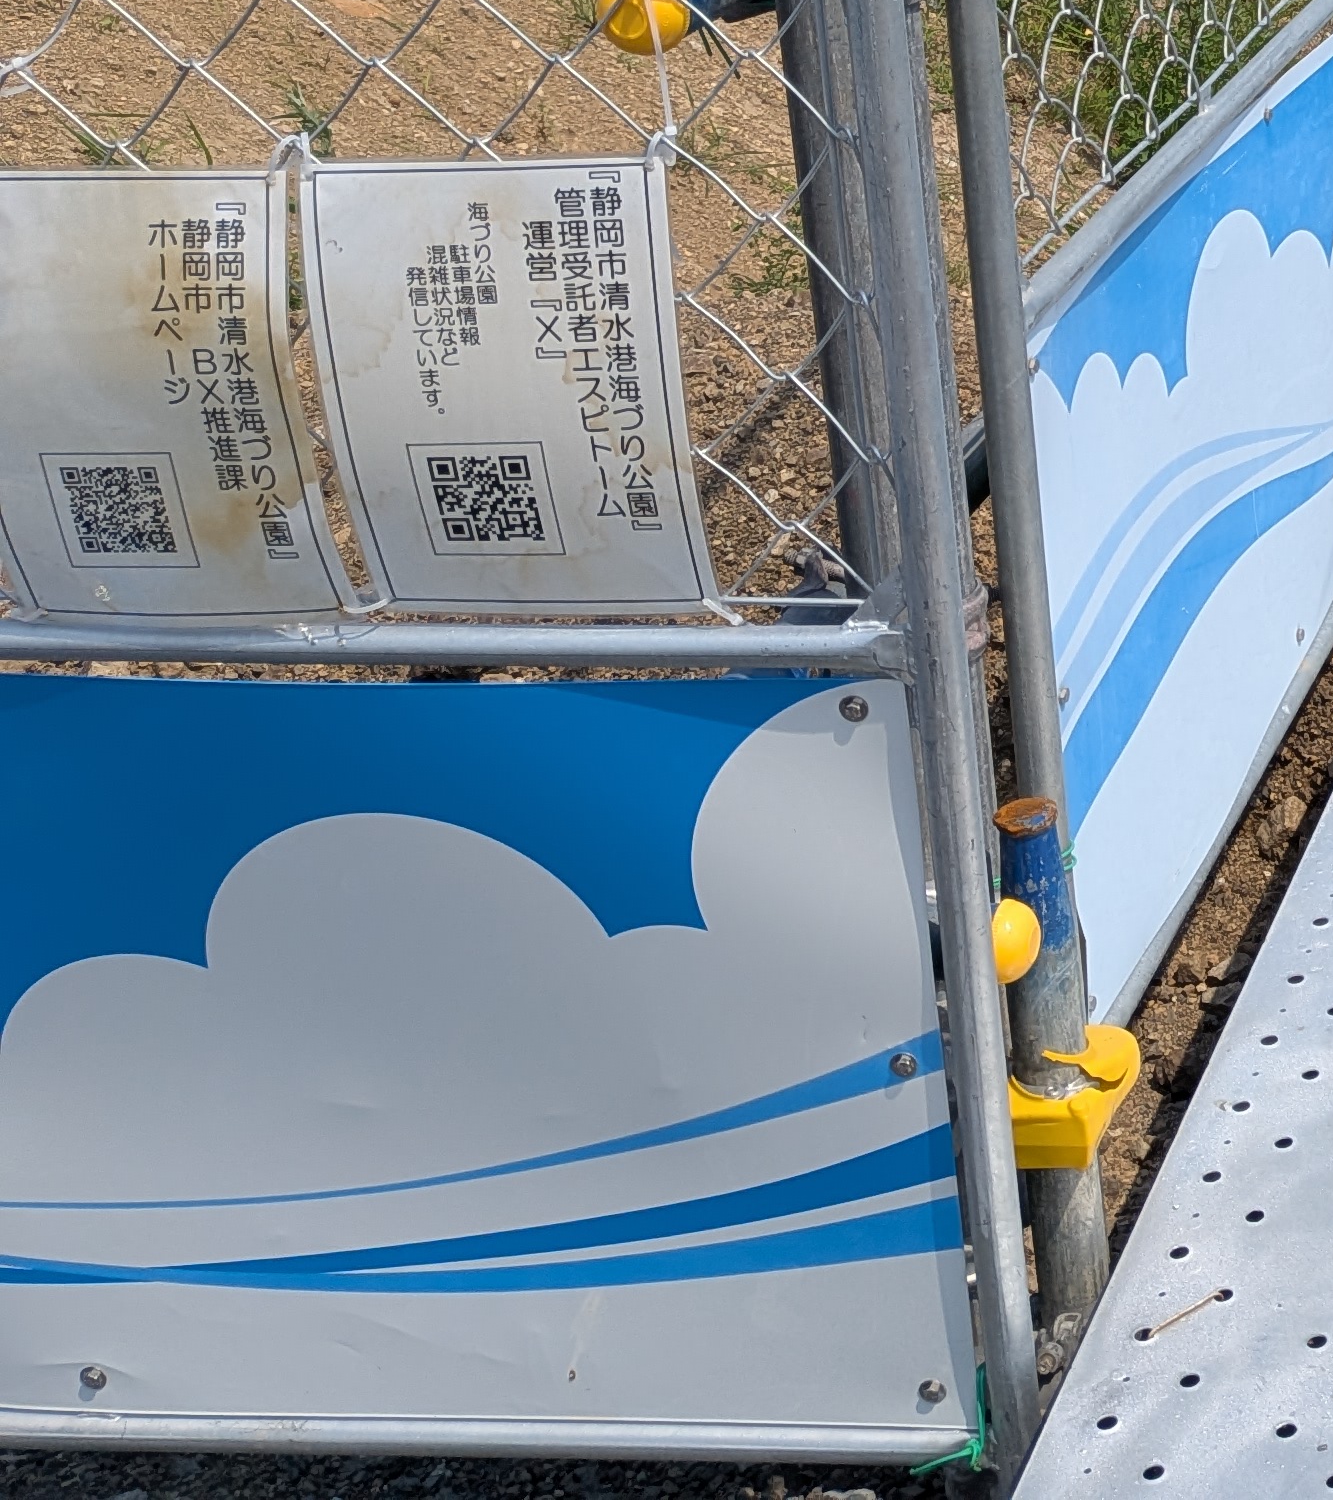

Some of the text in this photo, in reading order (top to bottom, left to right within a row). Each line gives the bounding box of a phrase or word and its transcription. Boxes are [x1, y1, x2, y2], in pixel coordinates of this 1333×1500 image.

[148, 219, 190, 405] ホームページ
[406, 266, 446, 415] 発信しています。
[426, 244, 460, 367] 混雑状況など
[449, 244, 481, 347] 駐車場情報
[467, 201, 498, 305] 海づり公園
[182, 218, 249, 492] 静岡市 BX推進課
[215, 201, 300, 560] 『静岡市清水港海づり公園』
[554, 186, 626, 518] 管理受託者エスピトーム
[588, 170, 663, 531] 『静岡市清水港海づり公園』
